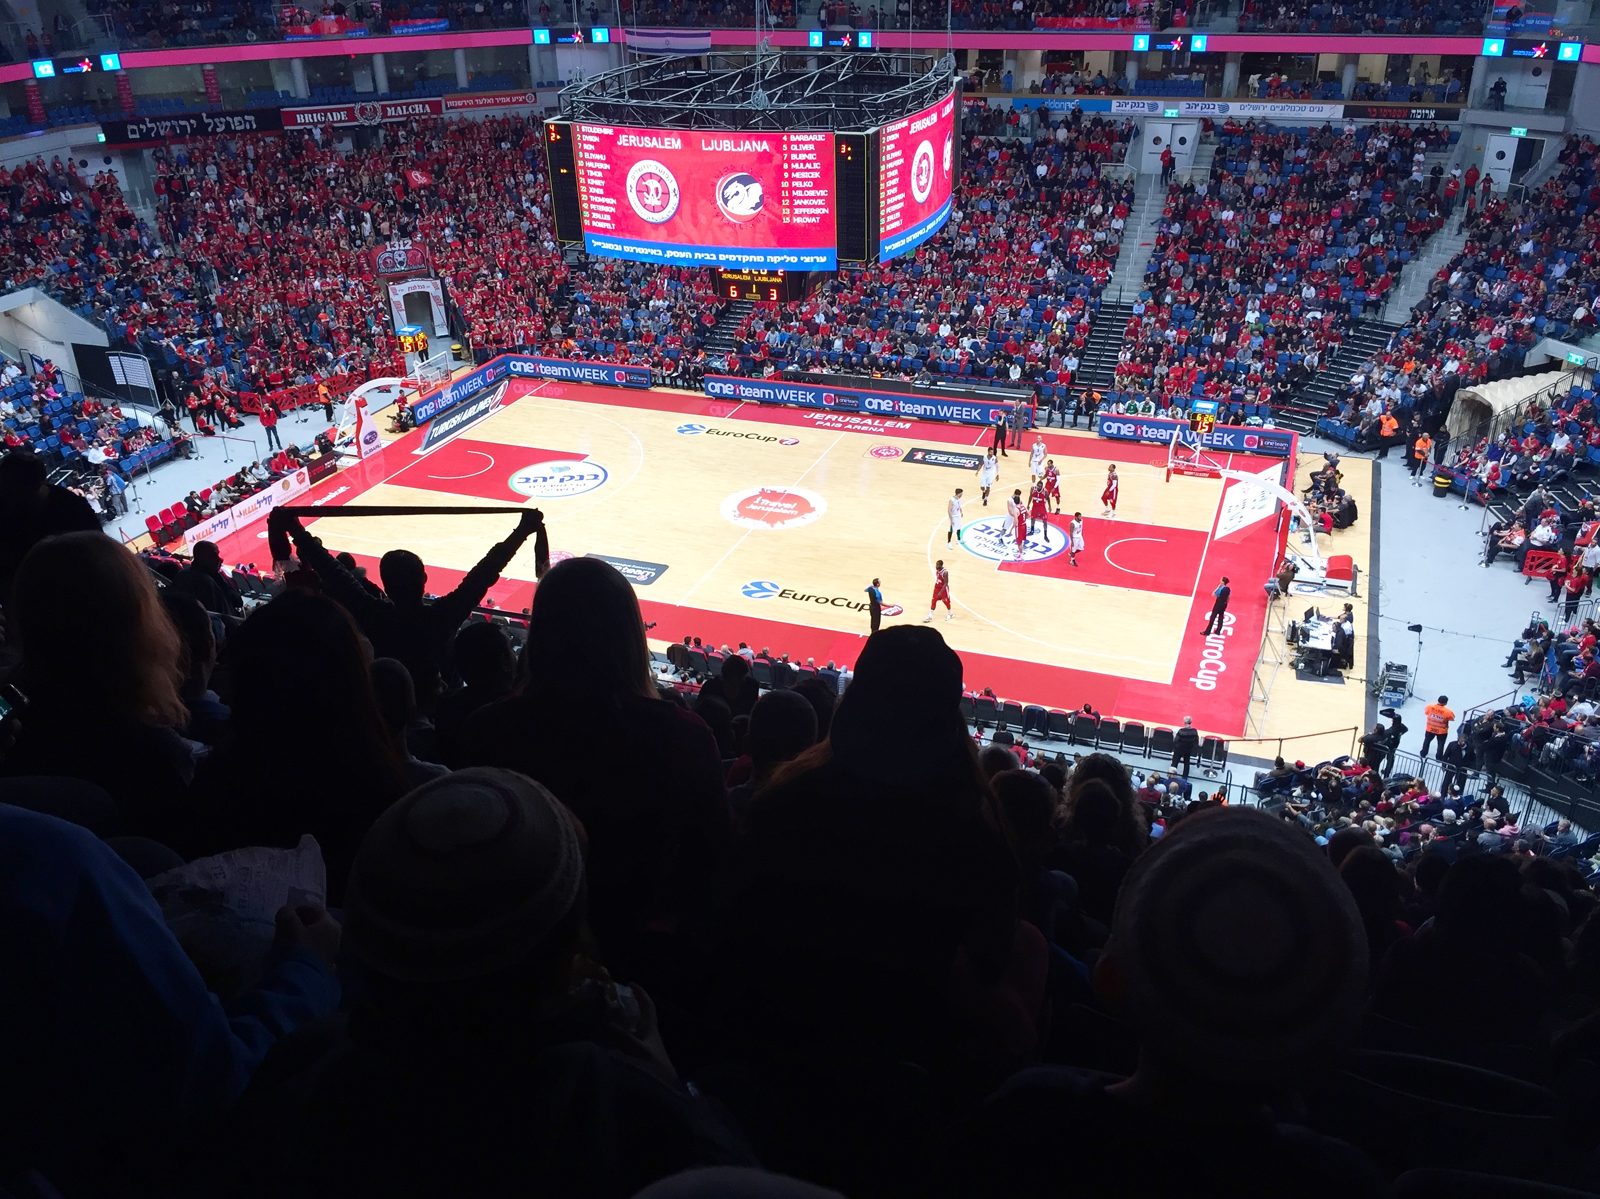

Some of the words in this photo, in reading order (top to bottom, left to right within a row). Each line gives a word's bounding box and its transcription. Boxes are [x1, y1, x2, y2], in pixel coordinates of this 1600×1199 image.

[1130, 101, 1146, 109] בנק
[296, 110, 348, 124] BRIGADE
[386, 104, 431, 117] MALCHA
[1410, 109, 1435, 119] ארומה
[127, 118, 197, 139] ירושלים
[202, 113, 257, 132] הפועל
[909, 112, 938, 135] JERUSALEM
[617, 134, 682, 150] JERUSALEM
[701, 139, 770, 152] LJUBLJANA
[385, 240, 413, 252] 1312
[694, 252, 717, 260] בבית
[718, 254, 764, 263] מתקדמים
[767, 255, 798, 264] סליקה
[730, 286, 737, 297] 6
[770, 289, 777, 300] 3
[570, 367, 609, 381] WEEK
[459, 375, 484, 398] WEEK
[775, 388, 816, 404] WEEK
[938, 404, 982, 421] WEEK
[1197, 414, 1214, 422] 6:26
[430, 412, 464, 440] TURKISH
[803, 412, 912, 430] JERUSALEM
[815, 420, 843, 429] PAIS
[846, 424, 886, 433] ARENA
[1198, 422, 1209, 432] 15
[705, 428, 778, 443] EuroCup
[1186, 430, 1236, 447] WEEK
[364, 443, 381, 456] SUBARU
[559, 473, 600, 483] בנק
[778, 589, 871, 612] EuroCup
